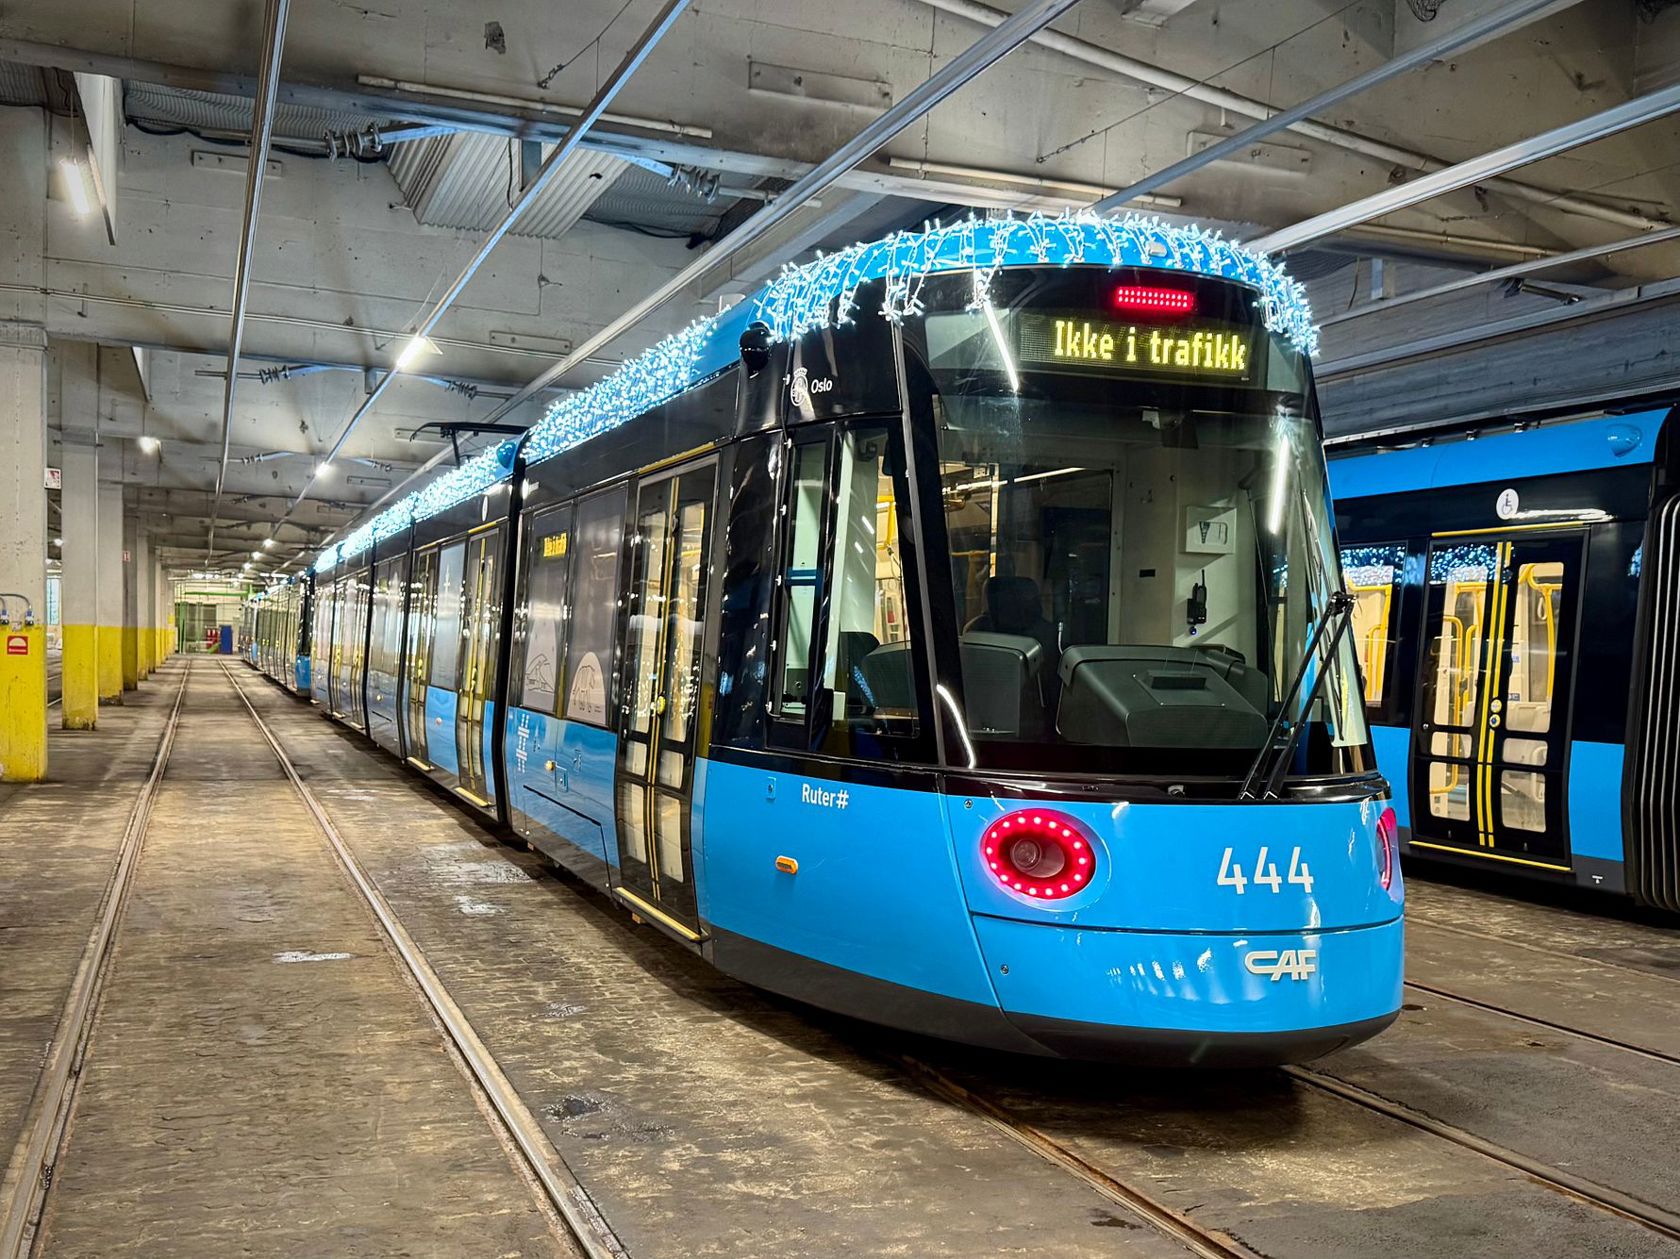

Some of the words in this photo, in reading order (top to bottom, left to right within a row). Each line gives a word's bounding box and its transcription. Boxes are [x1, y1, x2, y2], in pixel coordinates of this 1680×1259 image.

[1054, 320, 1114, 360] Ikke
[1126, 326, 1137, 362] i
[1150, 330, 1246, 370] trafikk
[811, 377, 833, 394] Oslo
[802, 783, 849, 809] Ruter#
[1217, 846, 1314, 894] 444
[1244, 949, 1317, 981] CAF
